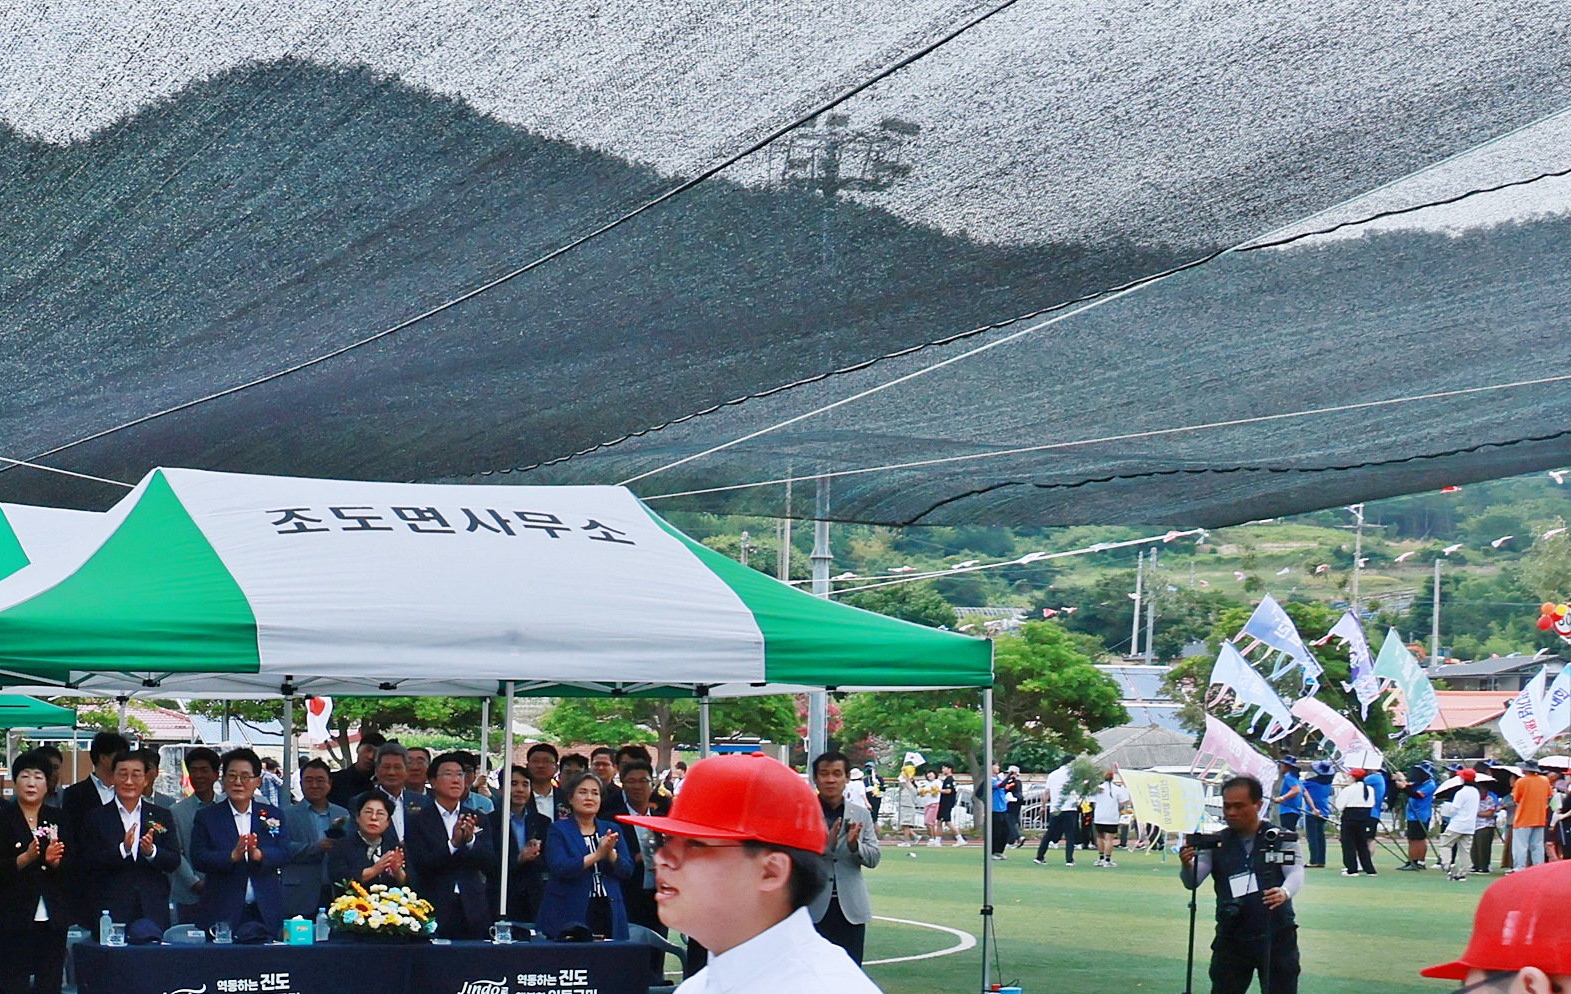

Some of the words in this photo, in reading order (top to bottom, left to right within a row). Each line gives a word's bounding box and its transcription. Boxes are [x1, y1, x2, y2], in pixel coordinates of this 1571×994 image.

[266, 506, 636, 545] 조도면사무소
[216, 980, 259, 993] 역동하는
[260, 973, 291, 991] 진도
[517, 974, 557, 987] 역동하는
[558, 969, 589, 986] 진도
